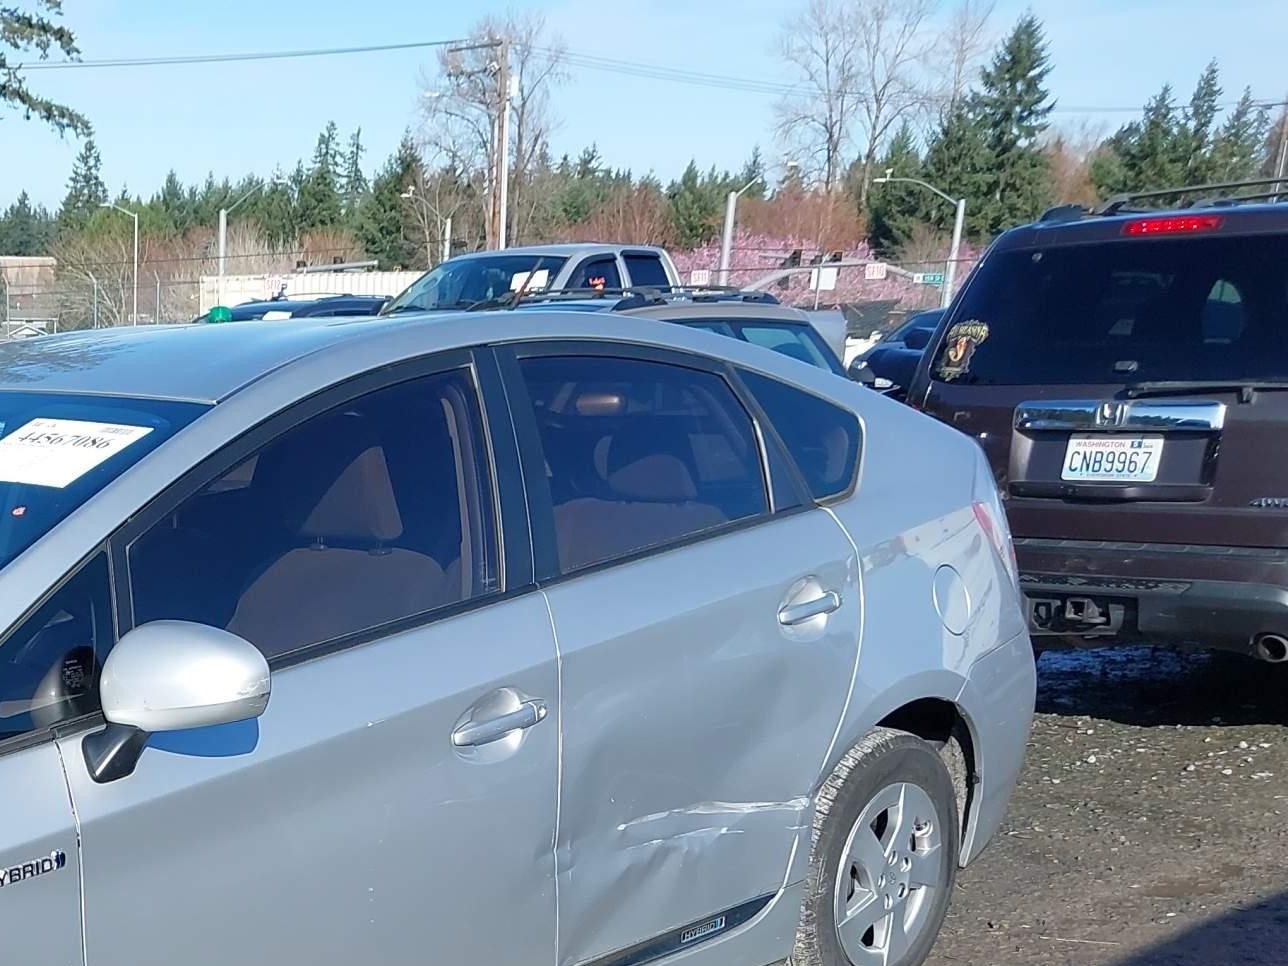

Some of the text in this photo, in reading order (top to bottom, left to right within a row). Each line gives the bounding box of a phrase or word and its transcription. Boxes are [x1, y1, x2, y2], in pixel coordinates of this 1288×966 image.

[18, 432, 116, 449] 44567086
[1075, 441, 1126, 449] WASHINGTON
[1068, 450, 1153, 473] CNB9967
